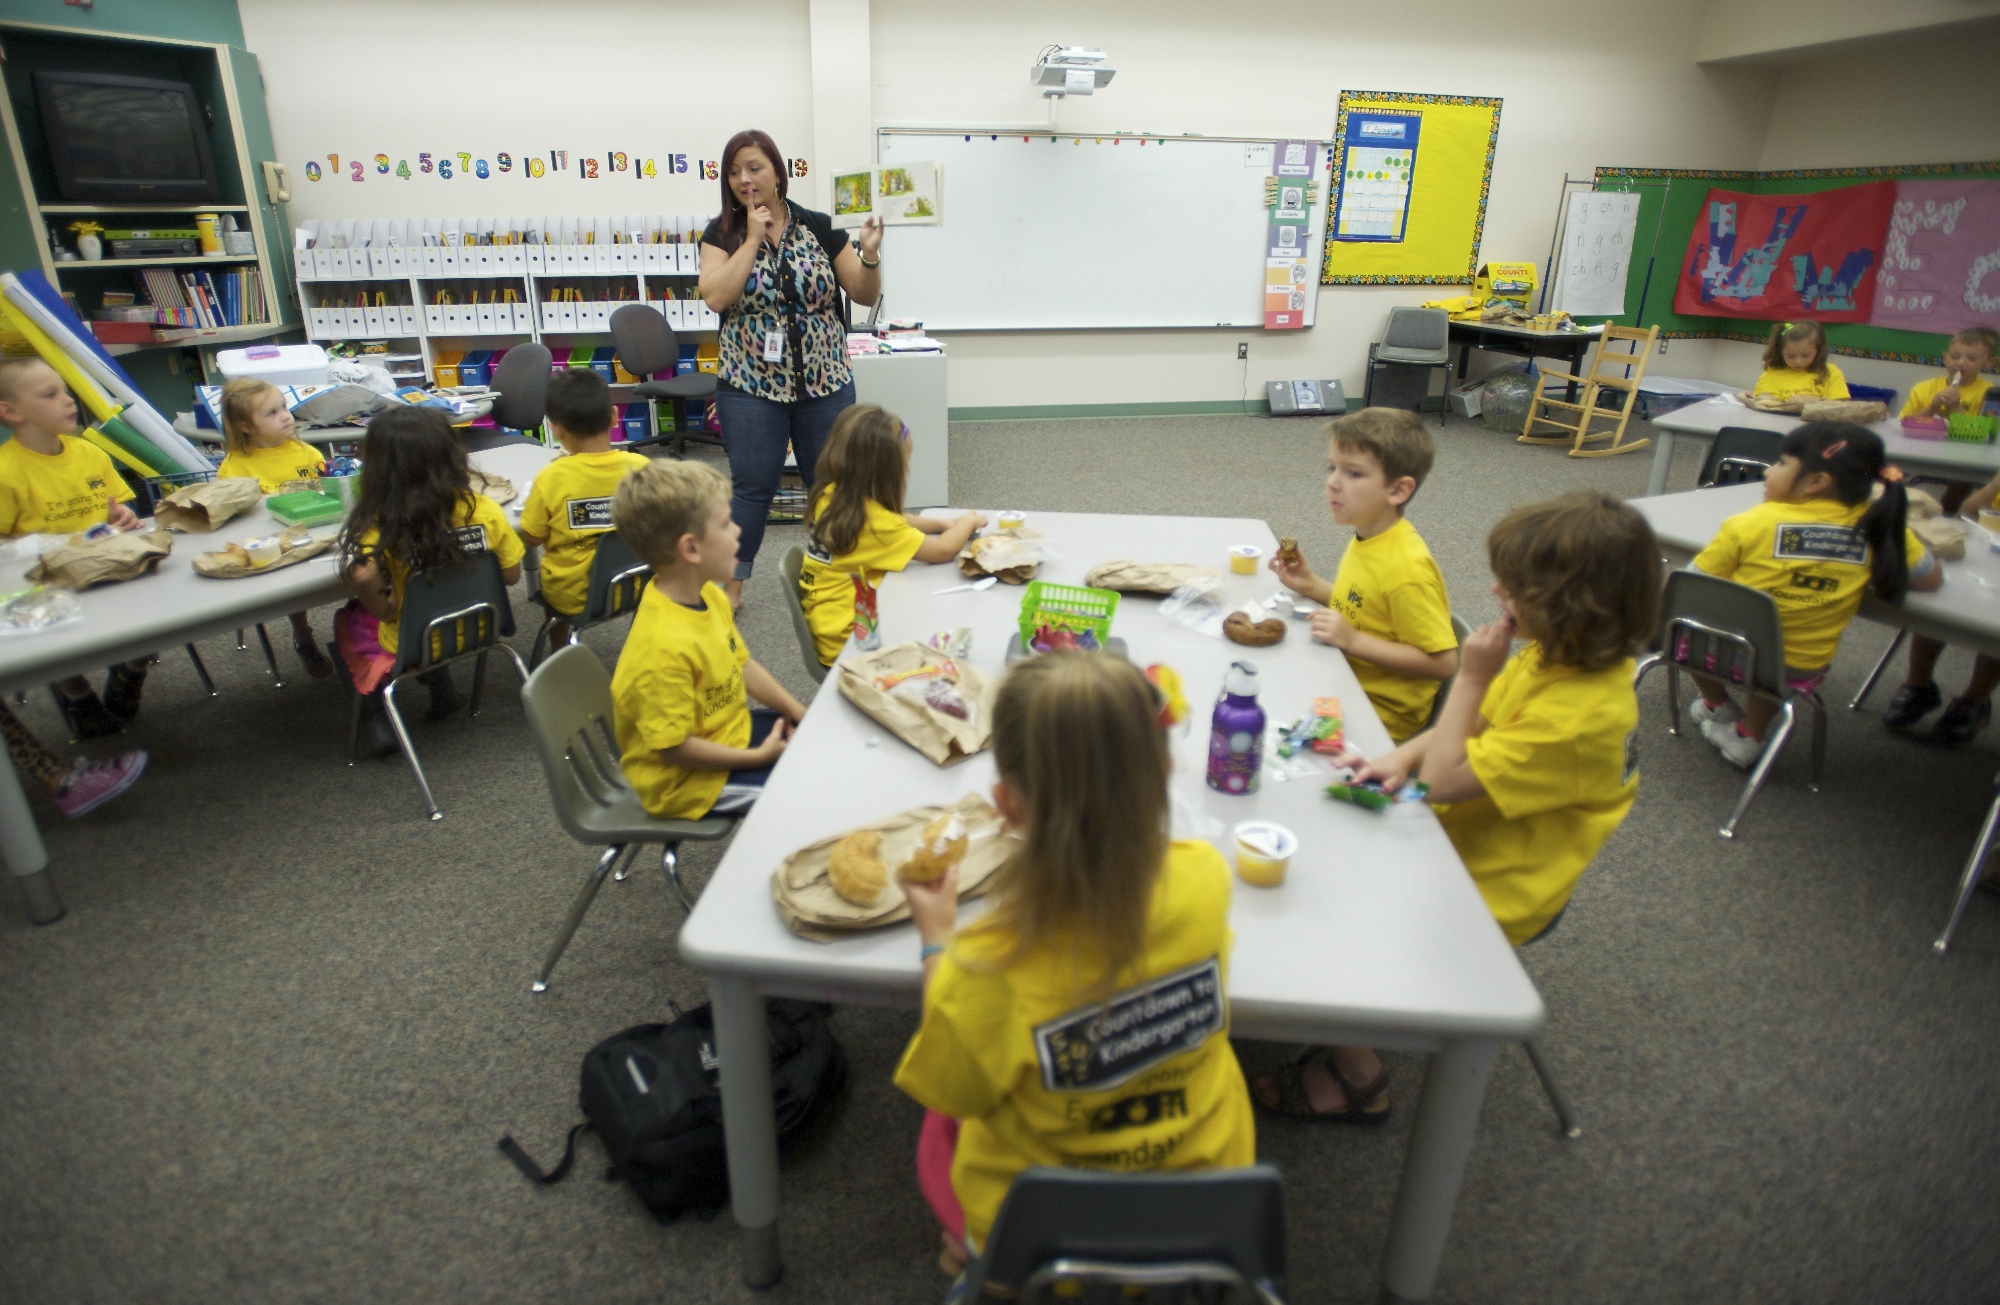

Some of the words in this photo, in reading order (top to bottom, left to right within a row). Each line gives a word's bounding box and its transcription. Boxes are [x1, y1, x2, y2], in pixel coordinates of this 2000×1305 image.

[327, 154, 339, 174] 1
[350, 161, 365, 182] 2
[374, 153, 389, 174] 3
[396, 160, 412, 180] 4
[419, 153, 434, 174] 5
[438, 159, 453, 180] 6
[457, 152, 471, 173] 7
[475, 159, 490, 180] 8
[497, 152, 513, 173] 9
[524, 157, 545, 179] 10
[550, 150, 568, 171] 11
[579, 158, 599, 180] 12
[608, 151, 628, 173] 13
[635, 159, 658, 180] 14
[668, 154, 689, 175] 15
[699, 159, 719, 181] 16
[787, 158, 808, 178] 19
[1601, 198, 1612, 213] ch
[1611, 227, 1623, 245] ch
[1572, 259, 1586, 276] ch
[67, 495, 92, 510] going
[93, 492, 107, 500] to
[44, 502, 108, 522] Kindergarte
[1085, 988, 1194, 1043] Countdown
[1101, 1002, 1216, 1066] Kindergarten
